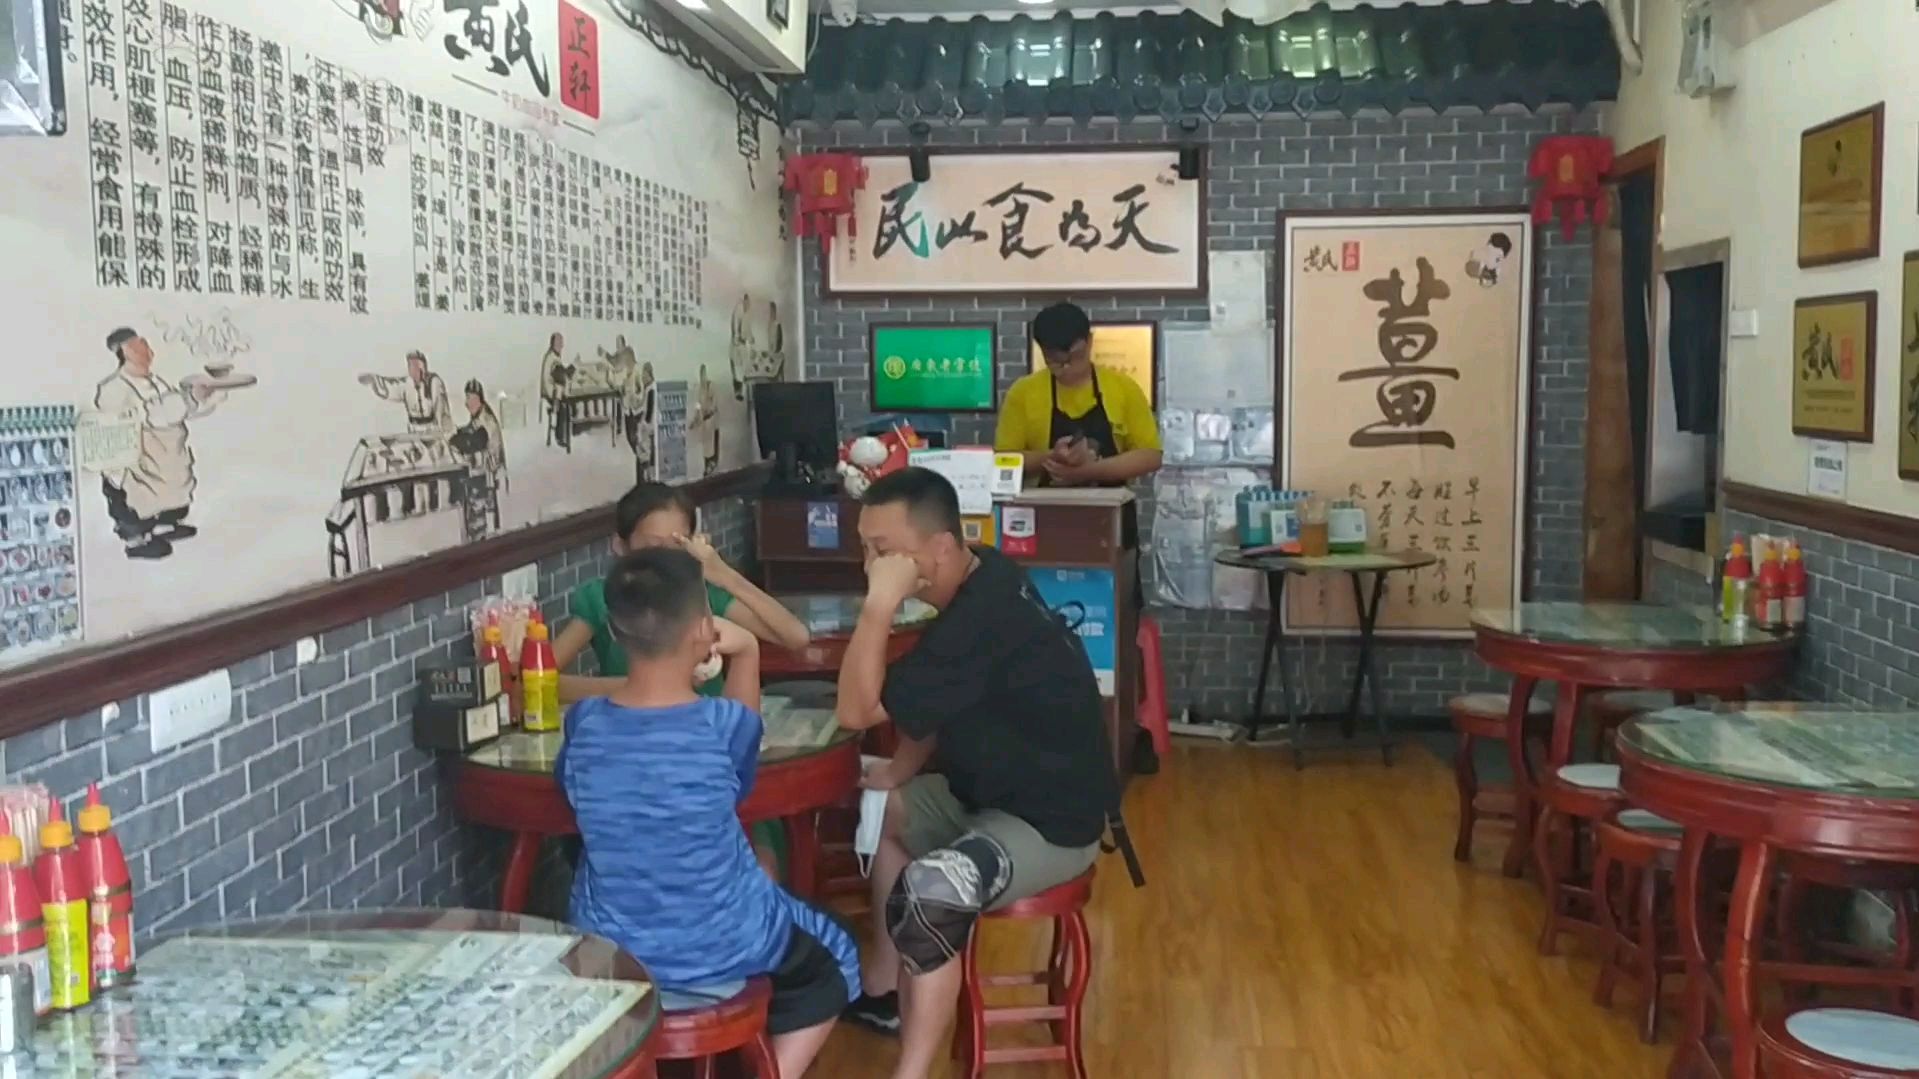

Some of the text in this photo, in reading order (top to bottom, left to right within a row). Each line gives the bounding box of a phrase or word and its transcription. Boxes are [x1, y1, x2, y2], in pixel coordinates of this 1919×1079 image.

[872, 180, 1180, 261] 民以食为天
